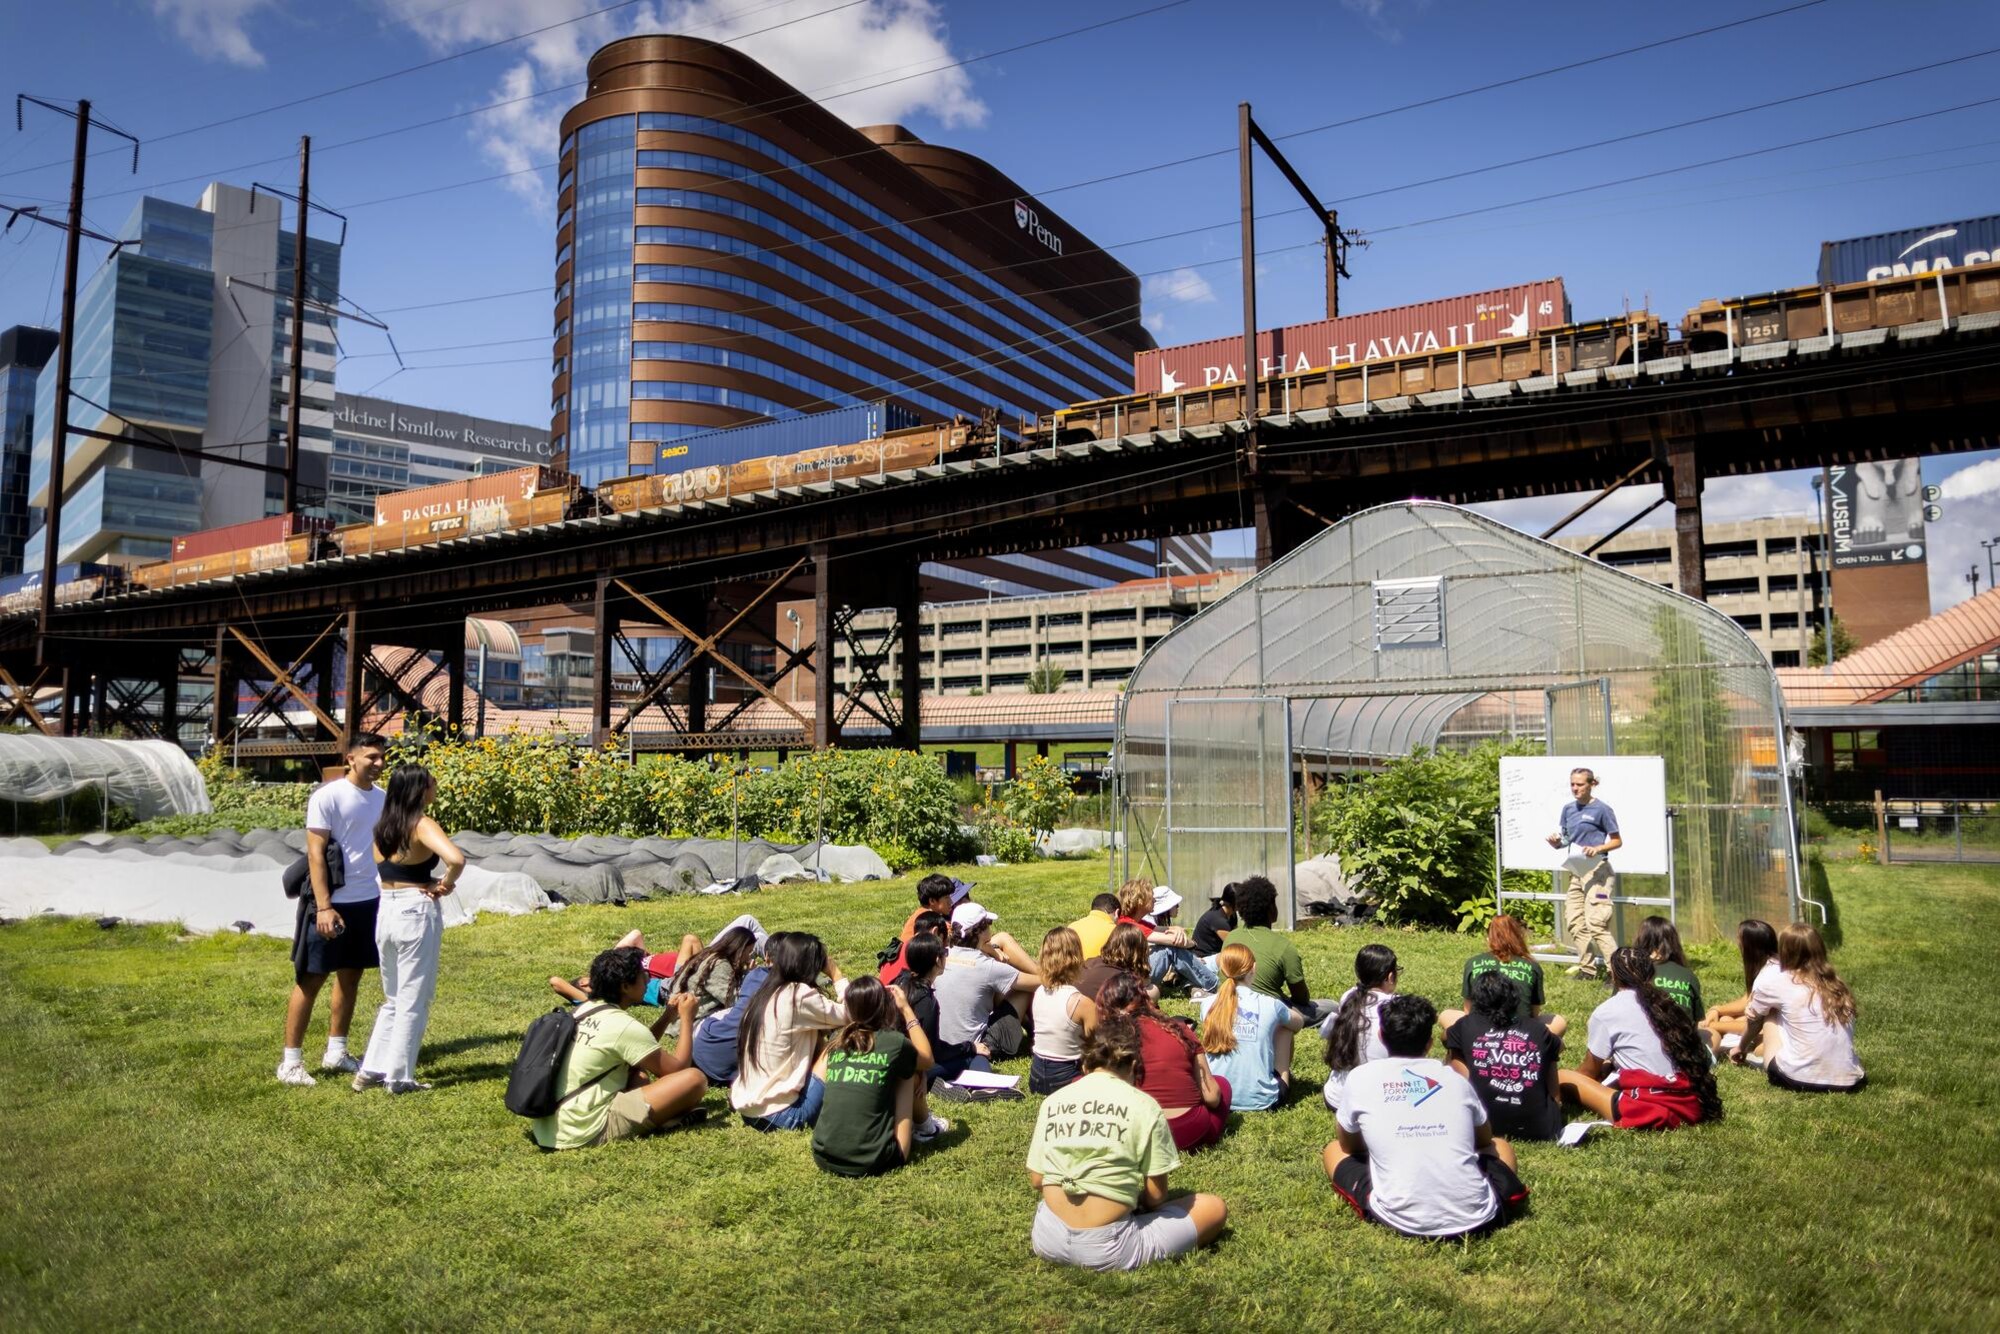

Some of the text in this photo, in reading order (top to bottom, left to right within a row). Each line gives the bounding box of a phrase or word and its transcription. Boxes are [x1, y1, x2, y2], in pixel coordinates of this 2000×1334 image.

[1029, 208, 1063, 256] Penn
[1539, 300, 1553, 315] 45
[1745, 324, 1780, 339] 125T
[1202, 322, 1475, 387] PAHA HAWAII
[398, 416, 458, 440] Smilow
[464, 428, 531, 454] Research
[662, 445, 688, 459] seaco
[617, 494, 632, 507] 53
[402, 502, 451, 522] PASHA
[430, 516, 462, 532] TTX
[1836, 557, 1857, 565] OPEN
[1871, 554, 1886, 562] ALL
[1491, 1049, 1527, 1066] Vote
[1383, 1081, 1411, 1089] PENN
[1384, 1087, 1426, 1096] FORWARD
[1384, 1095, 1407, 1103] 2023
[1047, 1102, 1077, 1119] Live
